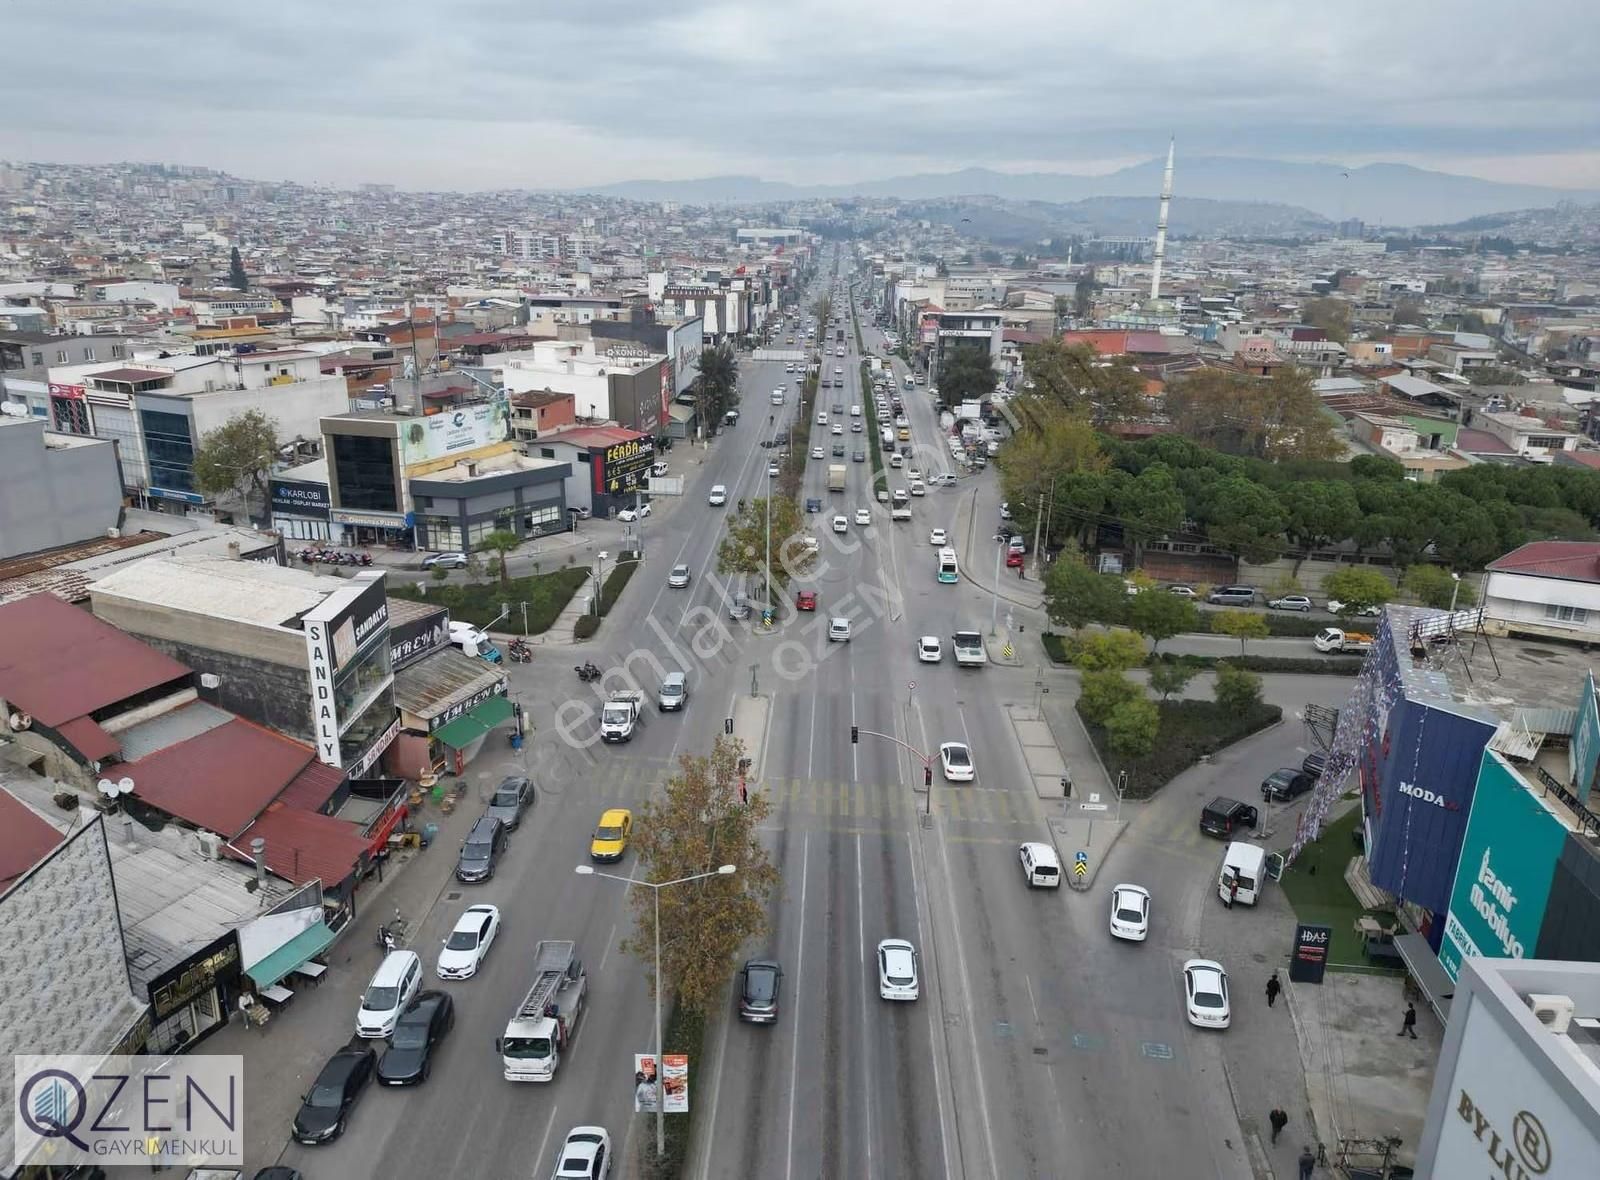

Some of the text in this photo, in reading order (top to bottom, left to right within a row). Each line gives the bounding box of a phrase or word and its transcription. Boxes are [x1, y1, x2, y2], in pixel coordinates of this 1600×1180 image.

[614, 348, 649, 358] KONFOR
[607, 442, 638, 461] FERDA
[287, 489, 321, 500] KARLOBİ
[355, 604, 387, 641] SANDALYE
[310, 626, 336, 766] SANDALY
[1399, 781, 1445, 807] MODA
